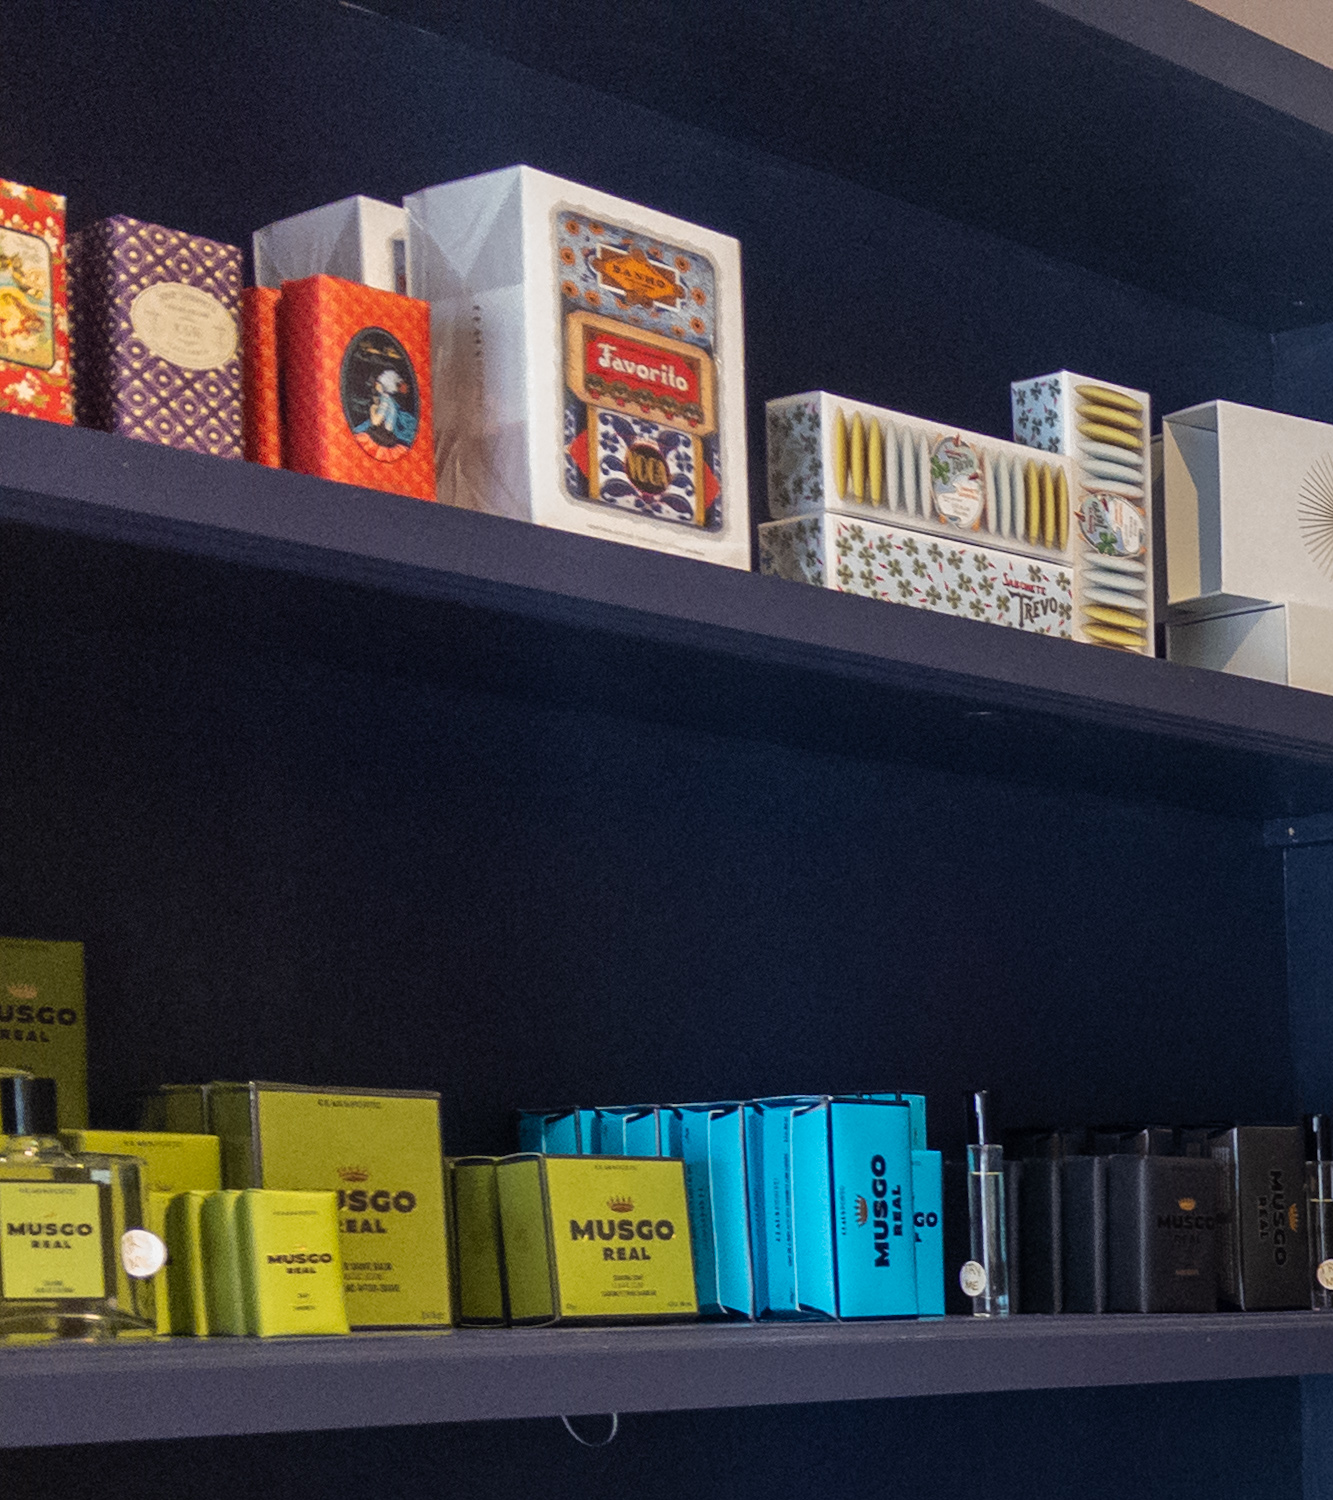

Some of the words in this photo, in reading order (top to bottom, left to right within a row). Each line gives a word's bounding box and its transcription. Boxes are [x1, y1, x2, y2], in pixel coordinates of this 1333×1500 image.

[597, 343, 689, 391] Favorito
[1006, 588, 1058, 628] TREVO
[0, 1004, 78, 1027] USGO
[338, 1189, 417, 1213] SGO
[871, 1154, 890, 1268] MUSGO
[892, 1185, 903, 1237] REAL
[7, 1222, 94, 1237] MUSGO
[1157, 1215, 1216, 1231] MUSGO
[1257, 1197, 1269, 1240] REAL
[1269, 1170, 1287, 1266] MUSGO
[569, 1219, 675, 1241] MUSGO
[30, 1239, 72, 1250] REAL
[603, 1247, 651, 1261] REAL
[267, 1253, 332, 1265] MUSGO
